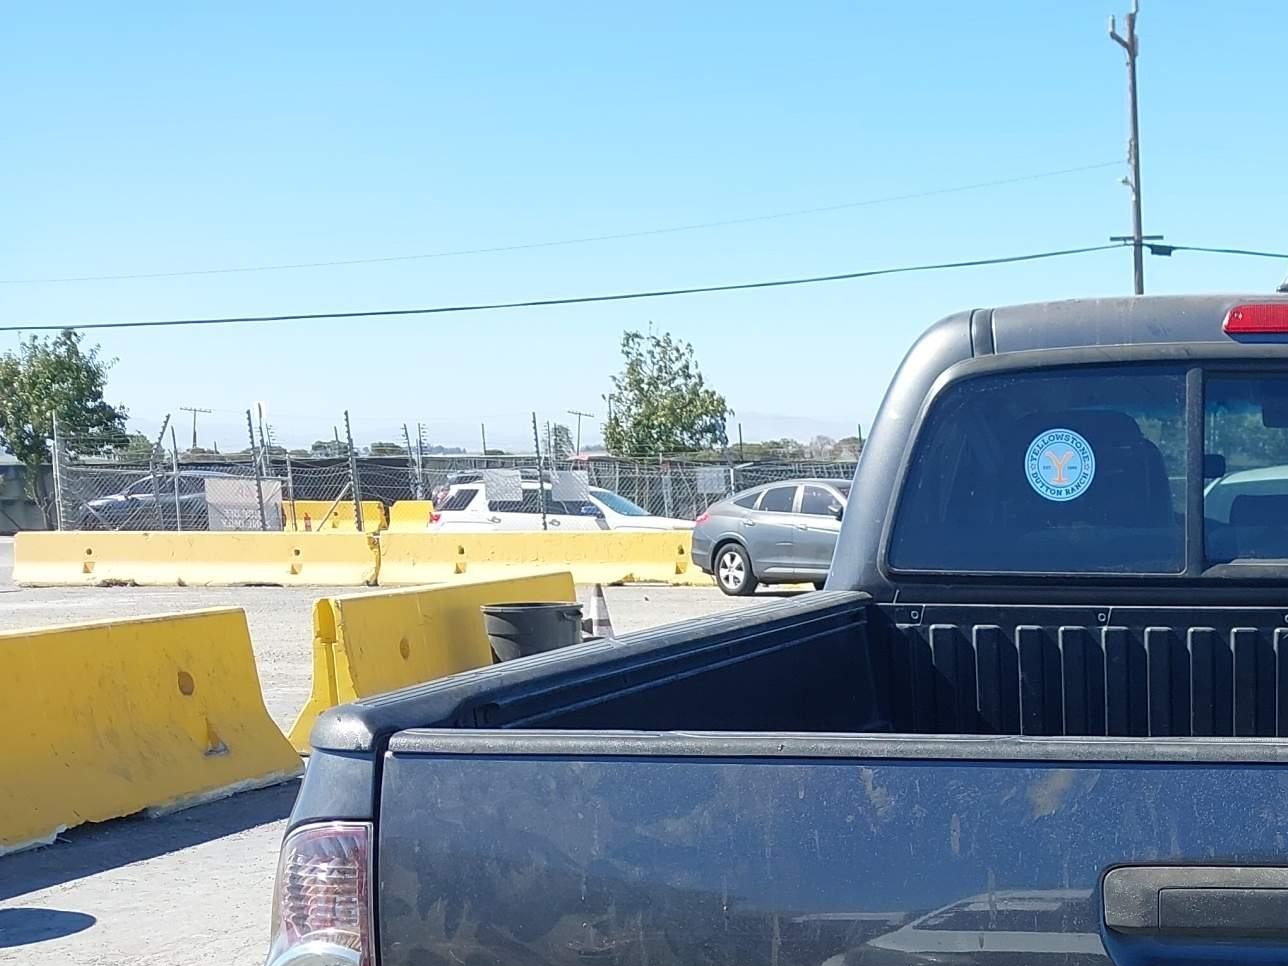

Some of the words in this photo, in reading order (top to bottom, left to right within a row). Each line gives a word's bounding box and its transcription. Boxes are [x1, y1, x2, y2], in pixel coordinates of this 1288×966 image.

[1030, 433, 1090, 461] YELLOWSTONE
[1031, 472, 1062, 496] DUTTON
[1065, 472, 1089, 496] RANCH
